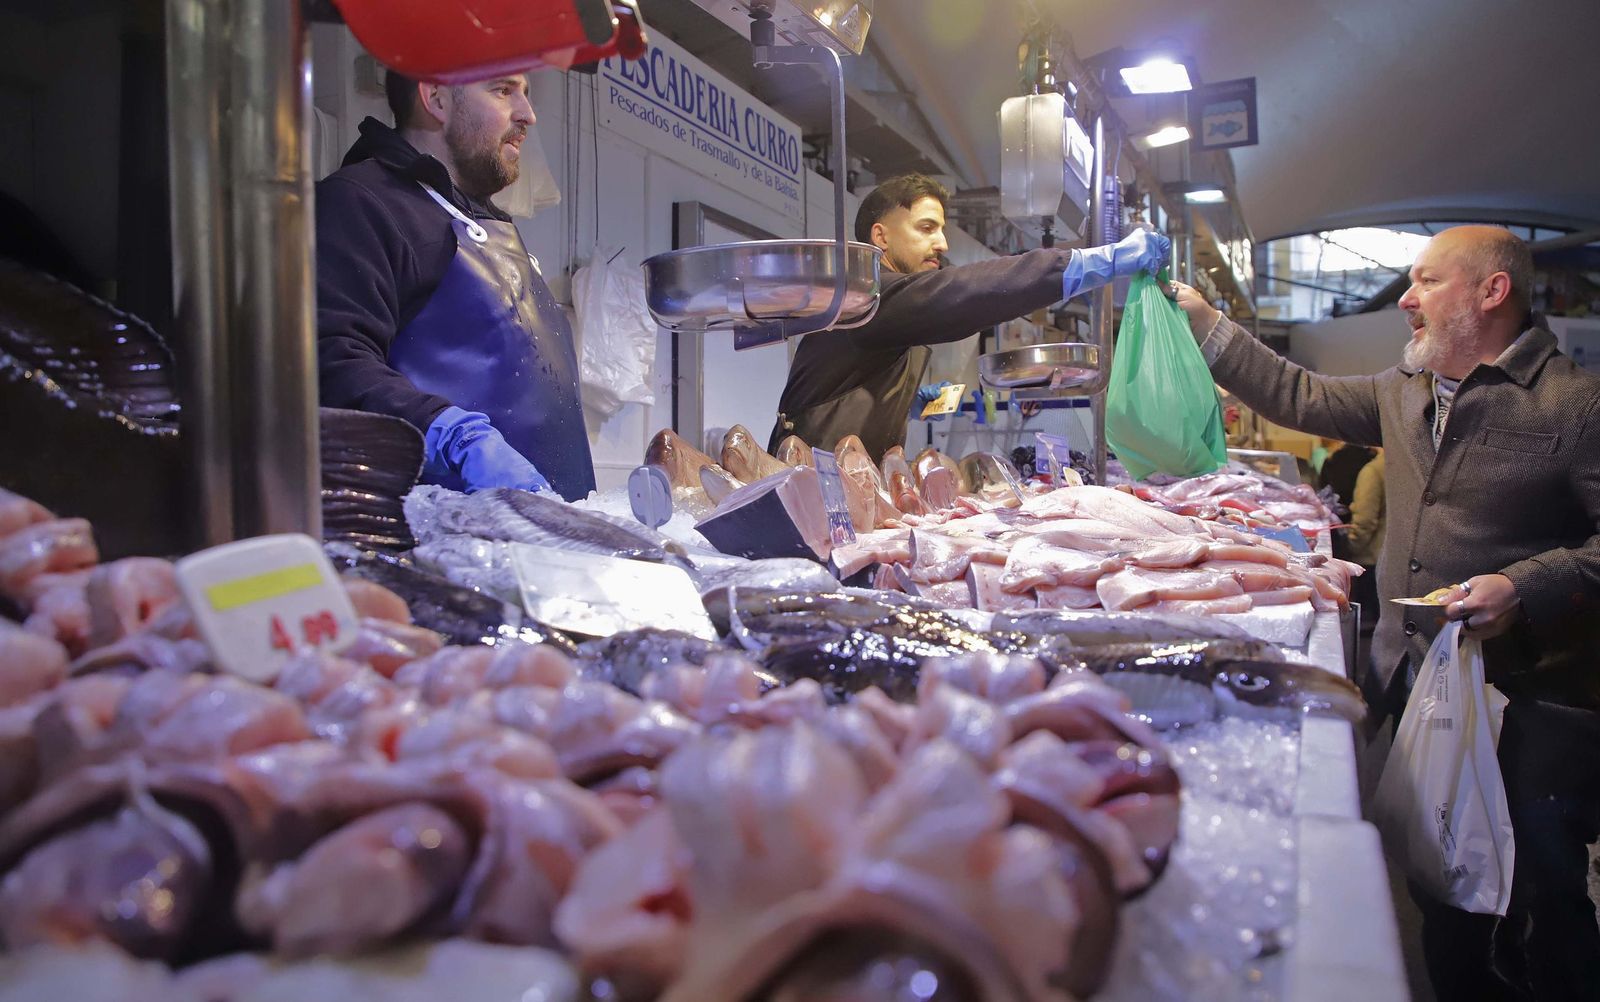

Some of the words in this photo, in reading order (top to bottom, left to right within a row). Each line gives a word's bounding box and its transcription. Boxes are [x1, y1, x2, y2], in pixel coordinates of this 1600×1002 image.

[604, 45, 740, 143] SCADERIA
[744, 108, 798, 175] CURRO
[610, 86, 669, 132] Pescados
[672, 121, 687, 142] de
[689, 129, 740, 170] Trasmallo
[742, 161, 749, 178] y
[751, 164, 763, 181] de
[764, 170, 773, 187] la
